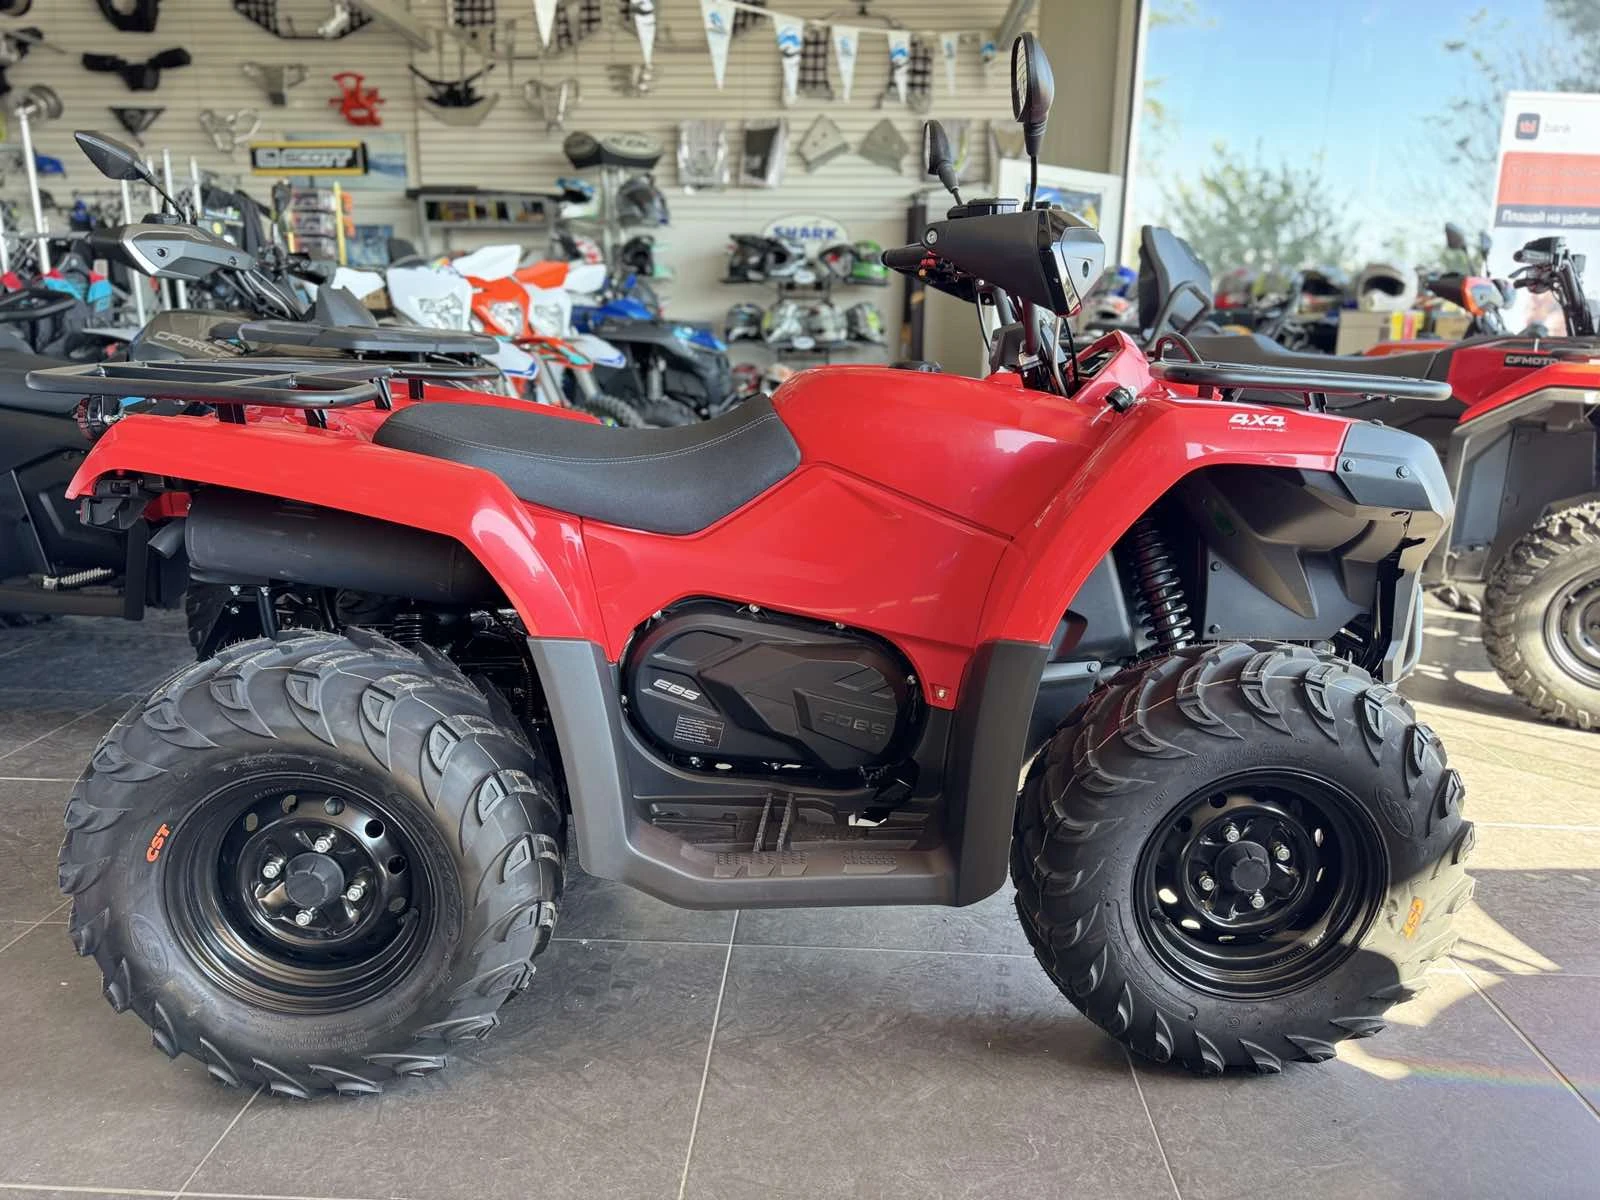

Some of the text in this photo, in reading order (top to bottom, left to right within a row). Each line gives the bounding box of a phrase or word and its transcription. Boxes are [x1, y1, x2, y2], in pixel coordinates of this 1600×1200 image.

[773, 225, 837, 240] SHARK
[653, 678, 701, 701] EBS
[146, 823, 170, 862] CST
